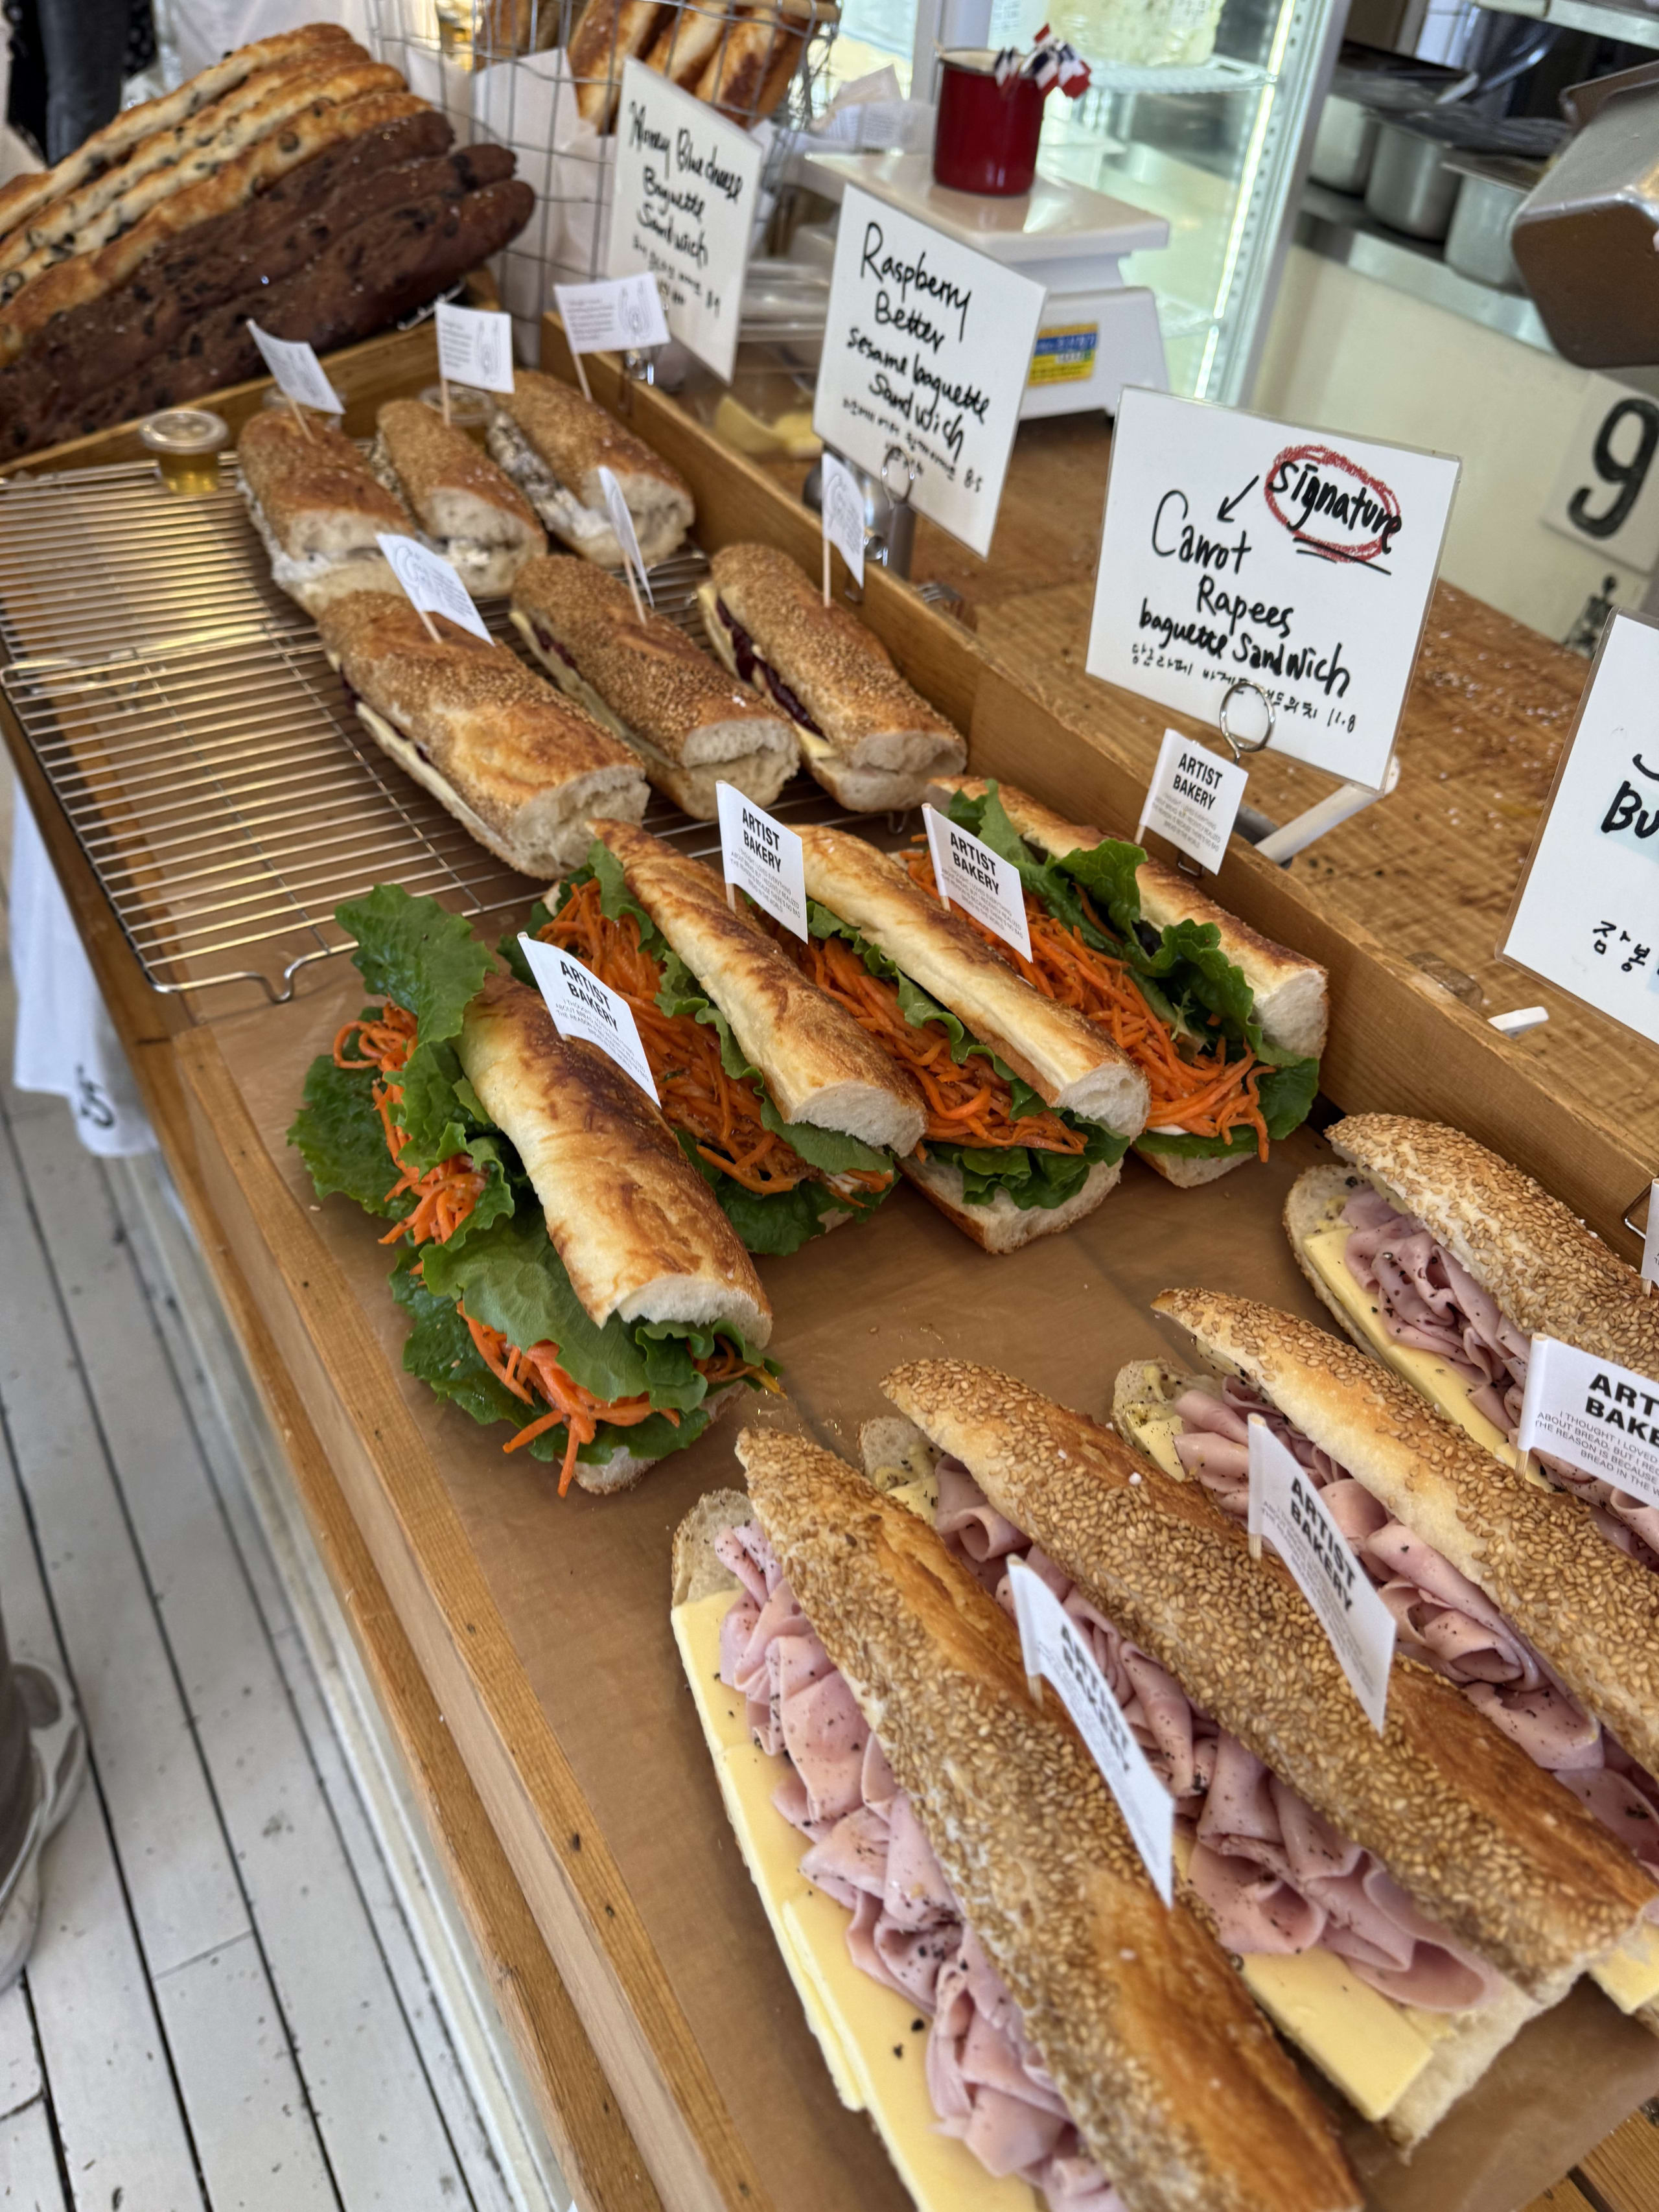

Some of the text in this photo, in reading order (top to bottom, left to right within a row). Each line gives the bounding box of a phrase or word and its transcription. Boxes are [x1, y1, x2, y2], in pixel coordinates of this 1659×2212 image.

[860, 222, 971, 342] Raspberry
[875, 290, 945, 355] Better
[869, 373, 964, 461] Sandwich
[913, 353, 990, 425] baguette
[1568, 398, 1659, 540] 9
[1152, 490, 1251, 574] Carrot
[1268, 461, 1402, 553] Signature
[1196, 574, 1294, 638] Rapees
[1139, 598, 1351, 698] baguette Sandwich
[1132, 644, 1193, 676] 당근라페
[1327, 708, 1358, 734] 11.8
[1173, 774, 1216, 810] BAKERY
[1178, 753, 1223, 789] ARTIST
[743, 808, 780, 851] ARTIST
[743, 830, 781, 872] BAKERY
[950, 832, 995, 876] ARTIST
[953, 852, 999, 895] BAKERY
[560, 960, 611, 1011] ARTIST
[566, 981, 618, 1032] BAKERY
[1535, 1420, 1658, 1485] THE REASON IS BECAUSE
[1537, 1412, 1572, 1430] ABOUT
[1613, 1446, 1635, 1461] BUT
[1566, 1413, 1616, 1442] THOUGHT
[1623, 1440, 1658, 1463] LOVED
[1581, 1449, 1614, 1471] BREAD
[1616, 1468, 1628, 1479] IN
[1630, 1474, 1649, 1491] THE
[1292, 1477, 1355, 1588] ARTIST
[1292, 1498, 1352, 1611] BAKERY
